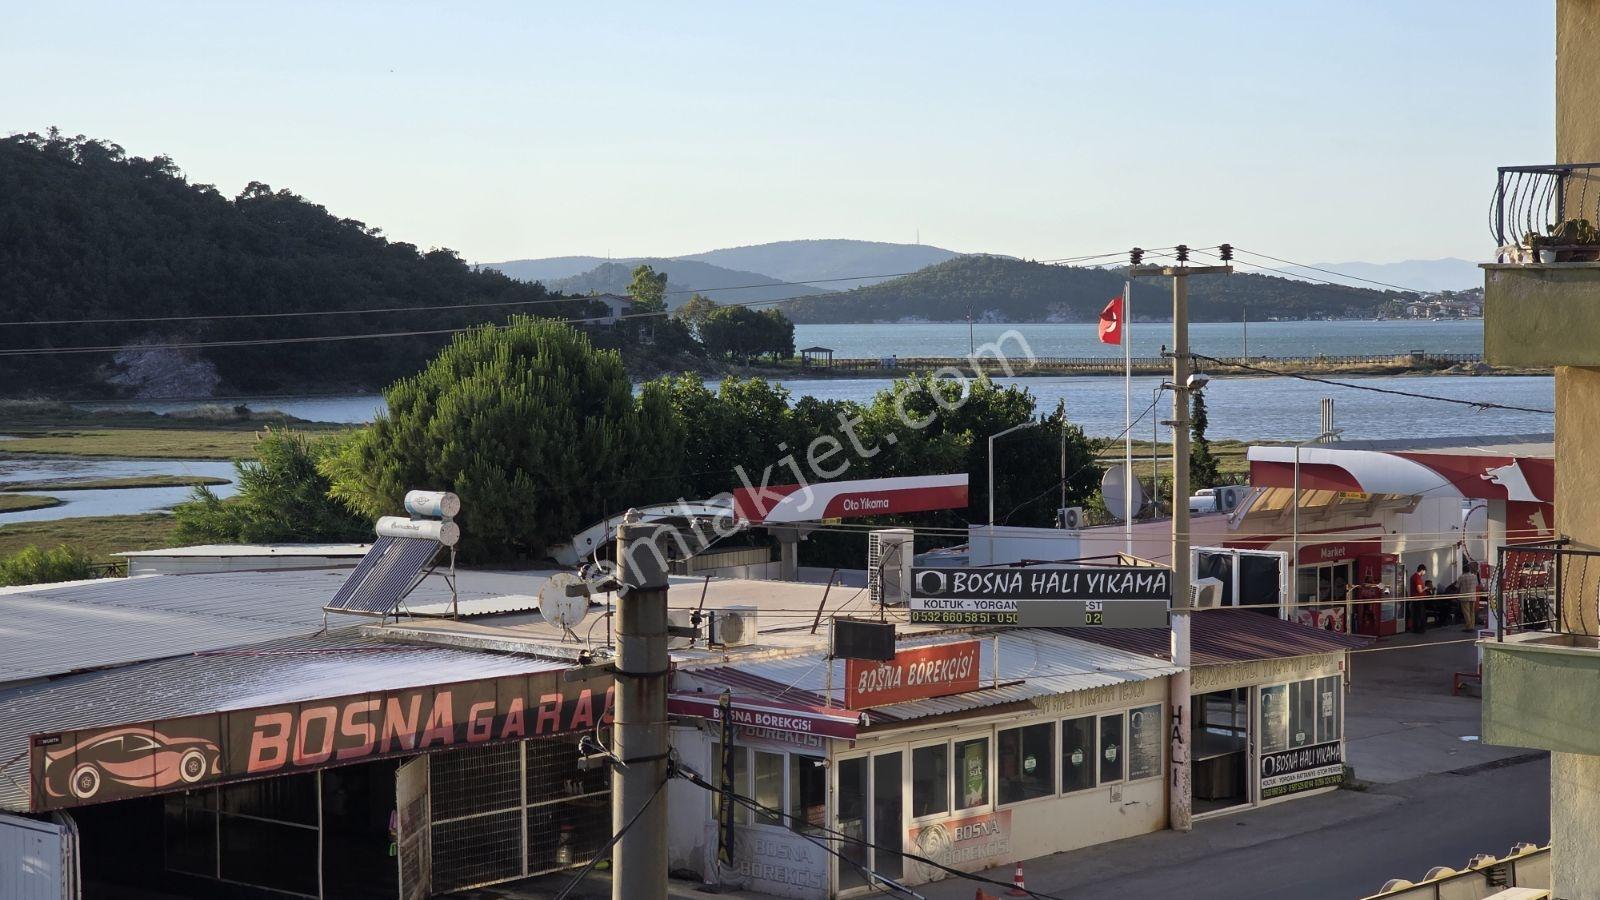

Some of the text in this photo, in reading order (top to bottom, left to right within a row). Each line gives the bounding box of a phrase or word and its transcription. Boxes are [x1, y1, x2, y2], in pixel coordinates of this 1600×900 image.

[843, 498, 859, 511] Oto
[1321, 545, 1346, 559] Market
[953, 571, 1167, 595] BOSNA HALI YIKAMA
[923, 599, 964, 609] KOLTUK
[858, 649, 975, 694] BOSNA BÖREKÇİSİ
[713, 707, 753, 723] BSNA
[247, 691, 454, 774] BOSNA
[1275, 751, 1298, 773] BOSNA
[954, 819, 1000, 842] BOSNA
